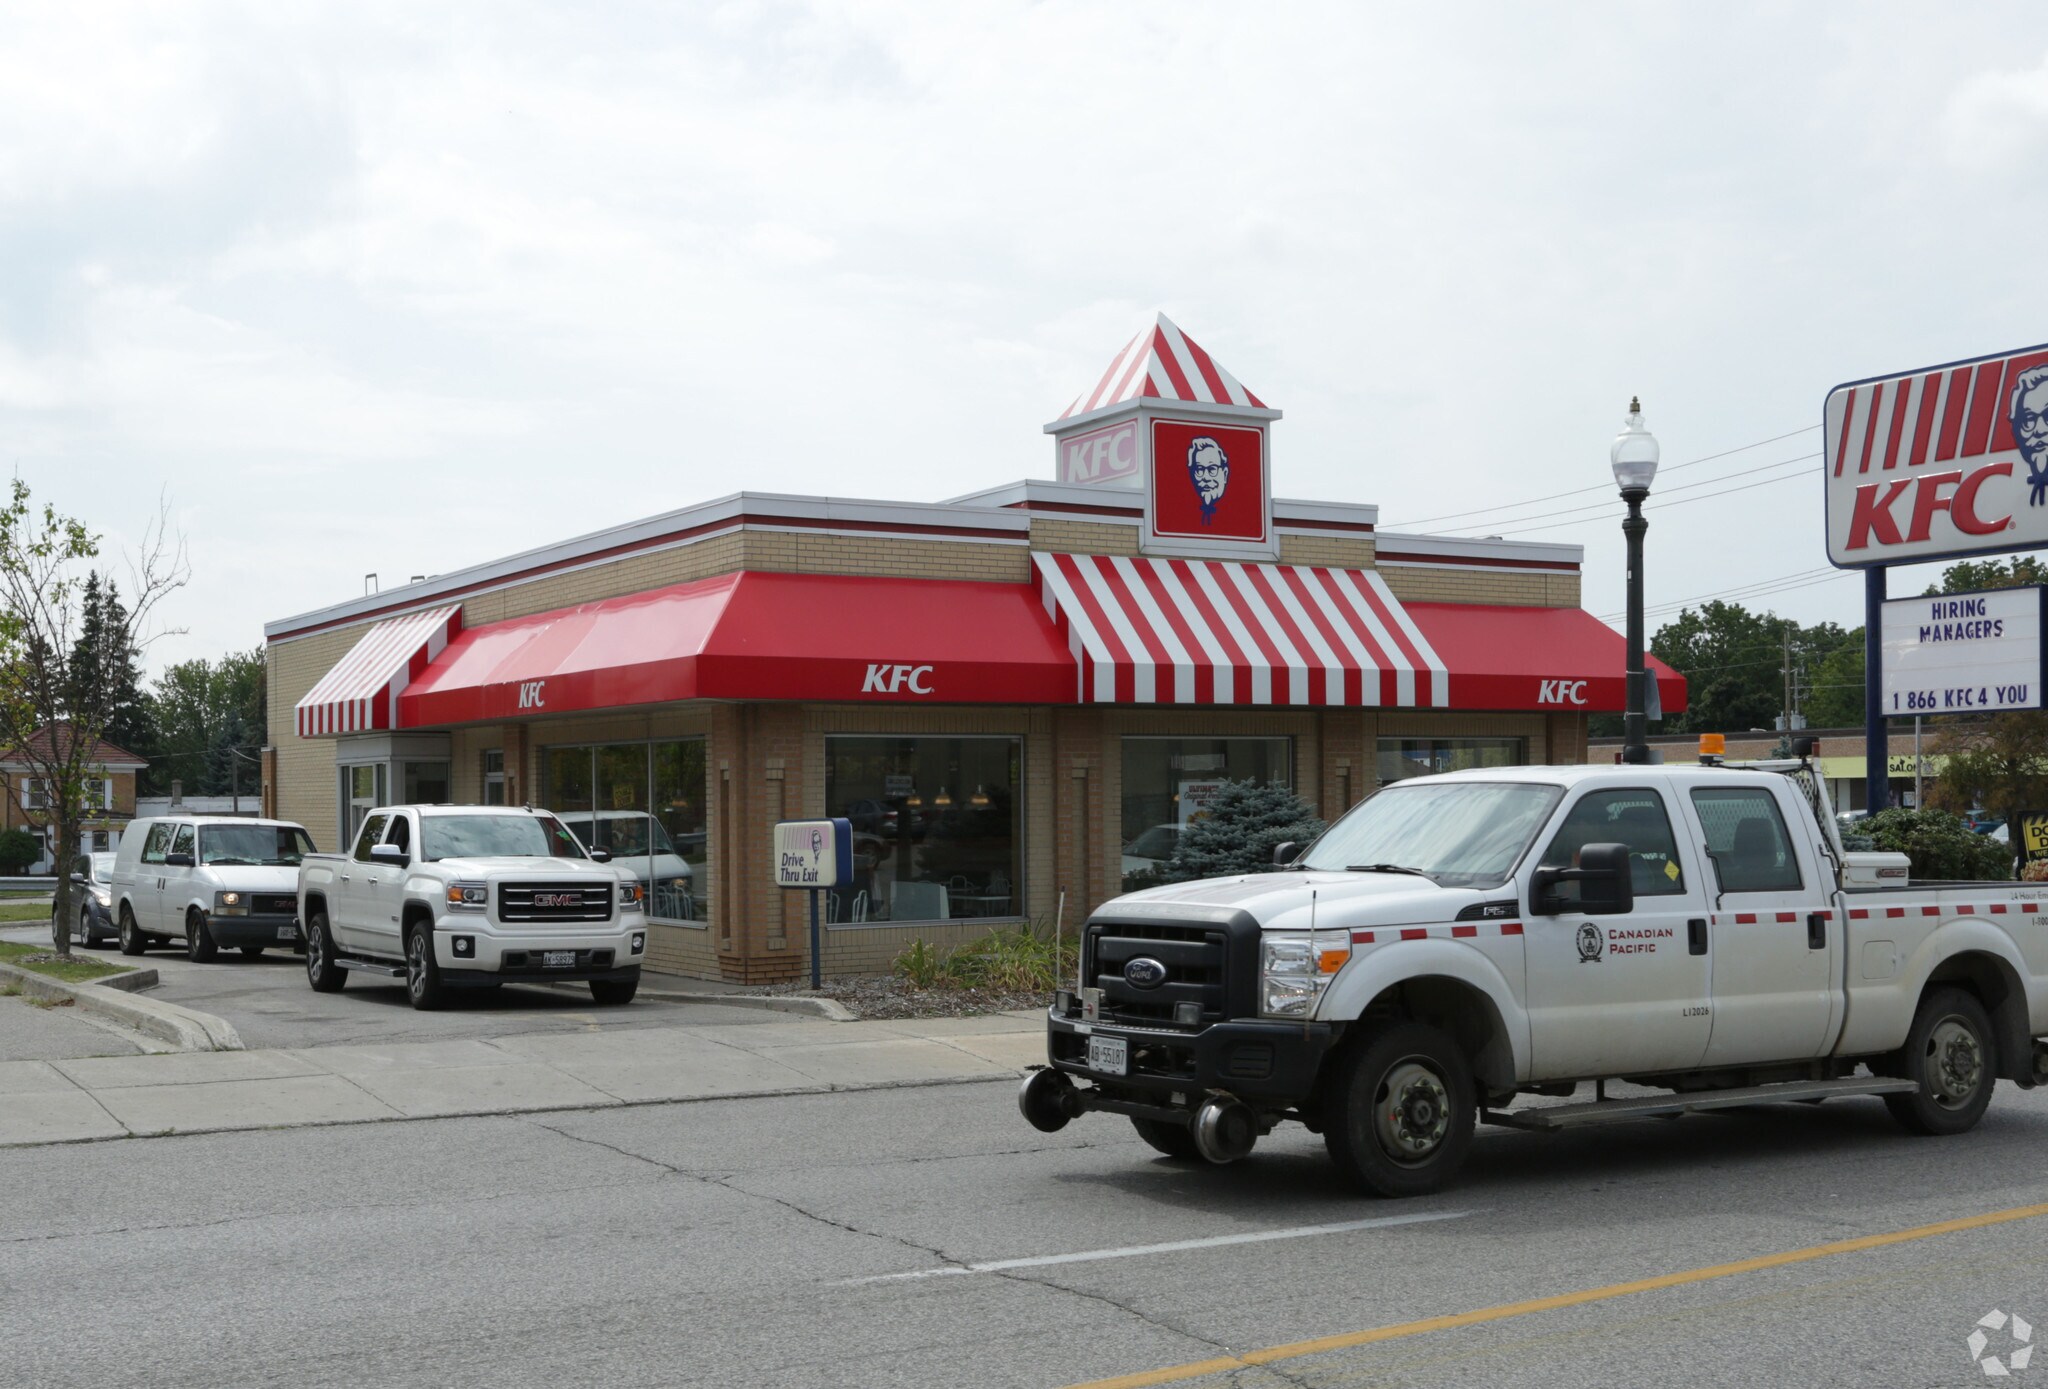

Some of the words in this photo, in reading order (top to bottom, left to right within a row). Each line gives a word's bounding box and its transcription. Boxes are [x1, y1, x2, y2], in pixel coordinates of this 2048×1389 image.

[1067, 429, 1132, 482] KFC
[1844, 462, 2014, 551] KFC
[1932, 598, 1986, 620] HIRING
[1919, 619, 2004, 643] MANAGERS
[861, 664, 934, 694] KFC
[518, 681, 545, 708] KFC
[1537, 679, 1588, 704] KFC
[1893, 692, 1899, 710] 1
[1907, 690, 1937, 709] 866
[1995, 684, 2028, 704] YOU
[781, 852, 804, 867] Drive
[781, 867, 800, 882] Thru
[802, 868, 819, 882] Exit
[535, 893, 582, 906] GMC
[1608, 928, 1673, 940] CANADIAN
[1609, 943, 1656, 954] PACIFIC
[1129, 962, 1153, 980] Ford
